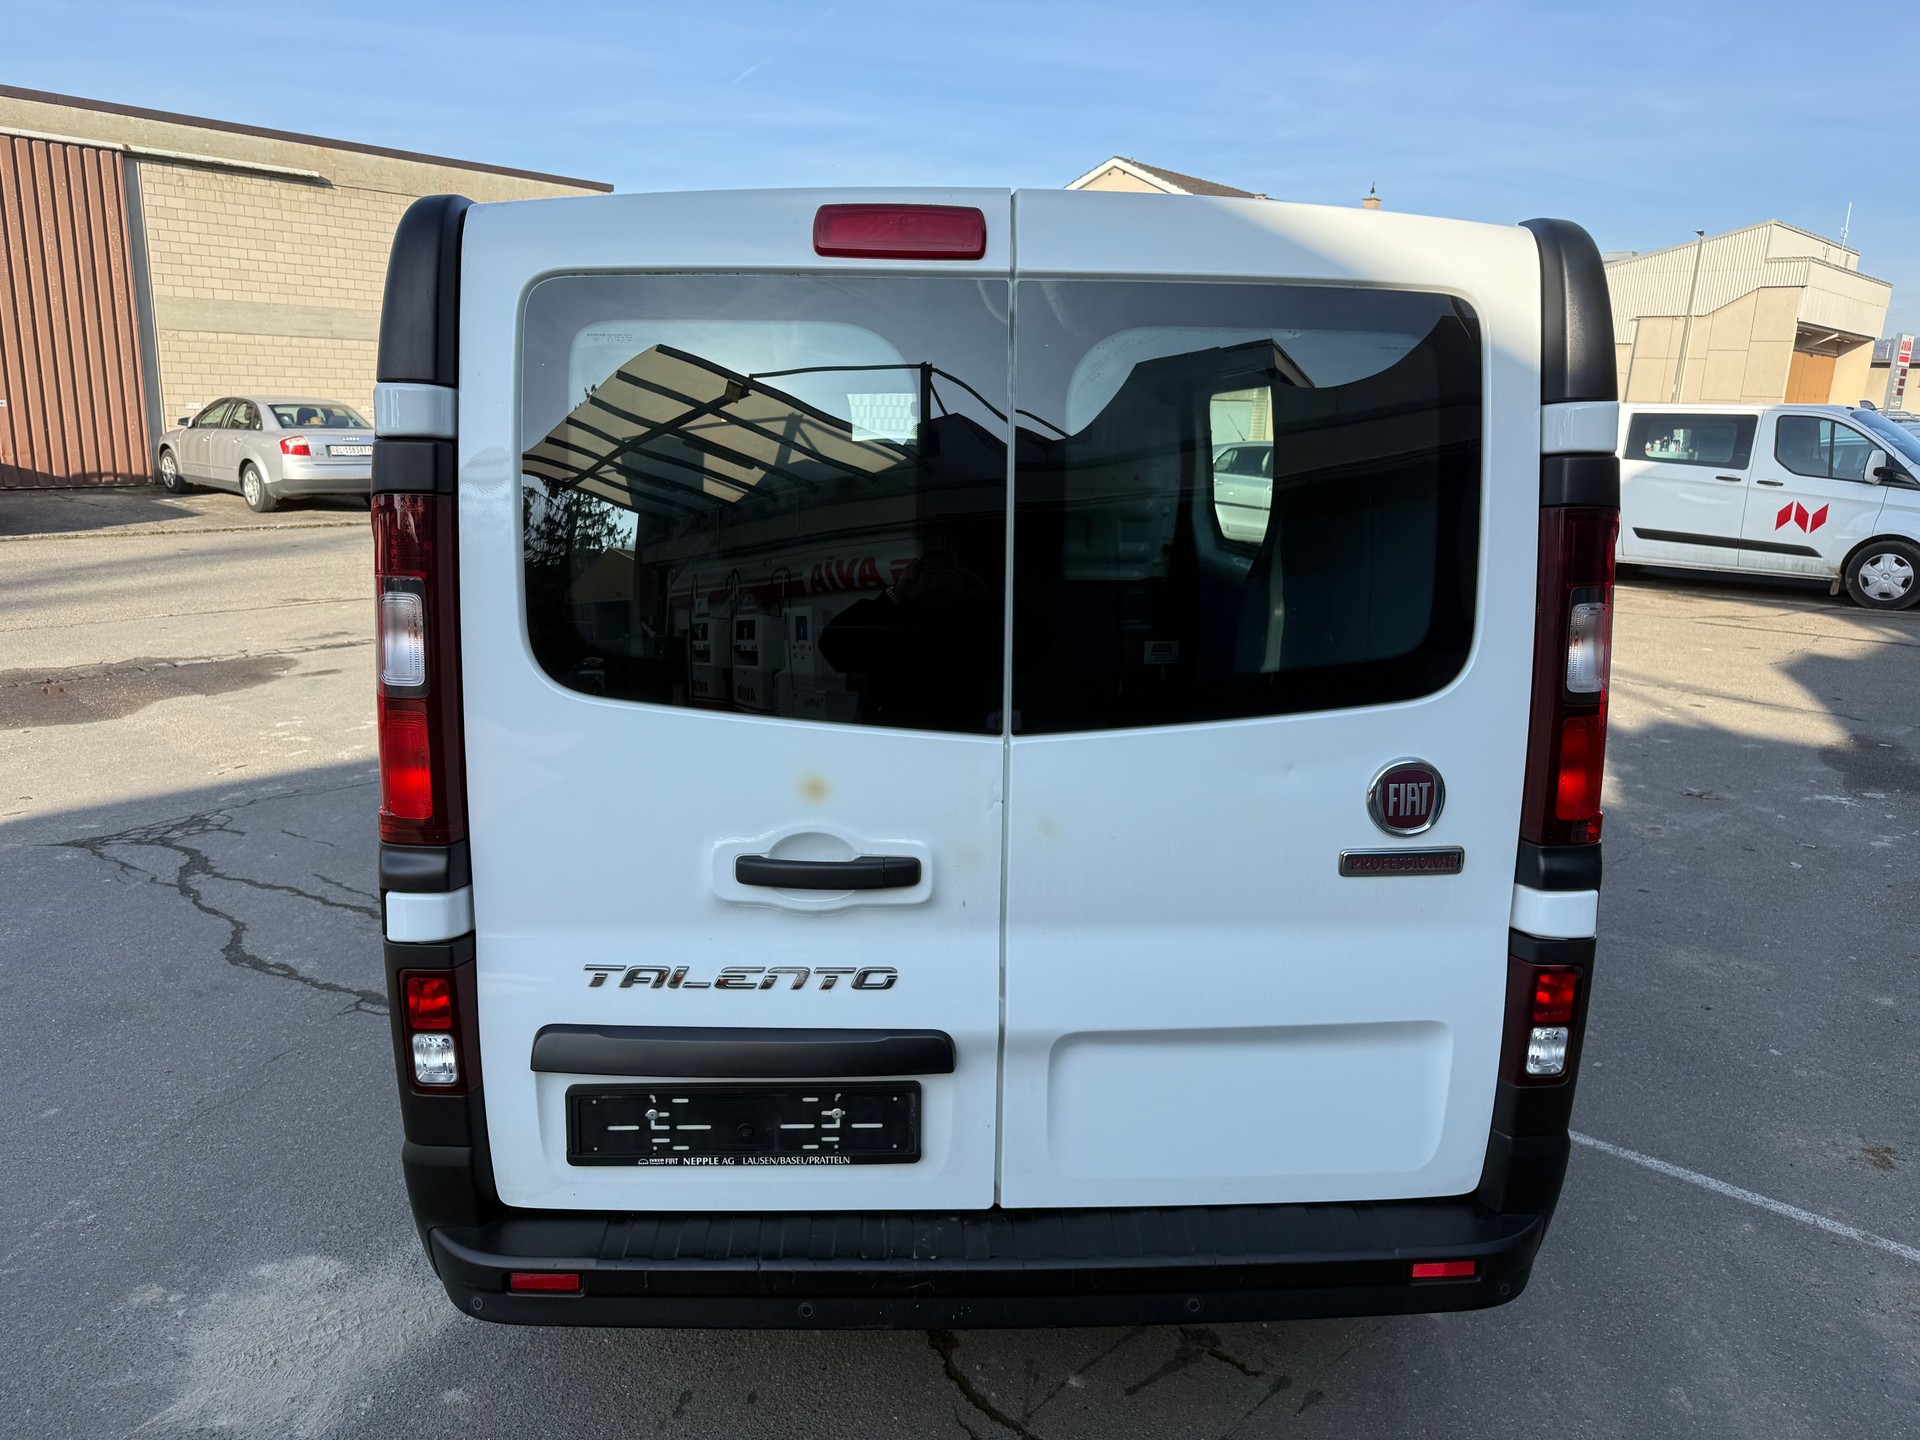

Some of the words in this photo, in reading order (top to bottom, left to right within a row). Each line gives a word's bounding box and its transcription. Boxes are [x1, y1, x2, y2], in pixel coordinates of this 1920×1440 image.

[1387, 782, 1432, 817] FIAT
[1350, 852, 1459, 871] PROFESSIONAL
[583, 963, 898, 990] TALENTO
[683, 1157, 719, 1165] NEPPLE
[721, 1156, 735, 1165] AG
